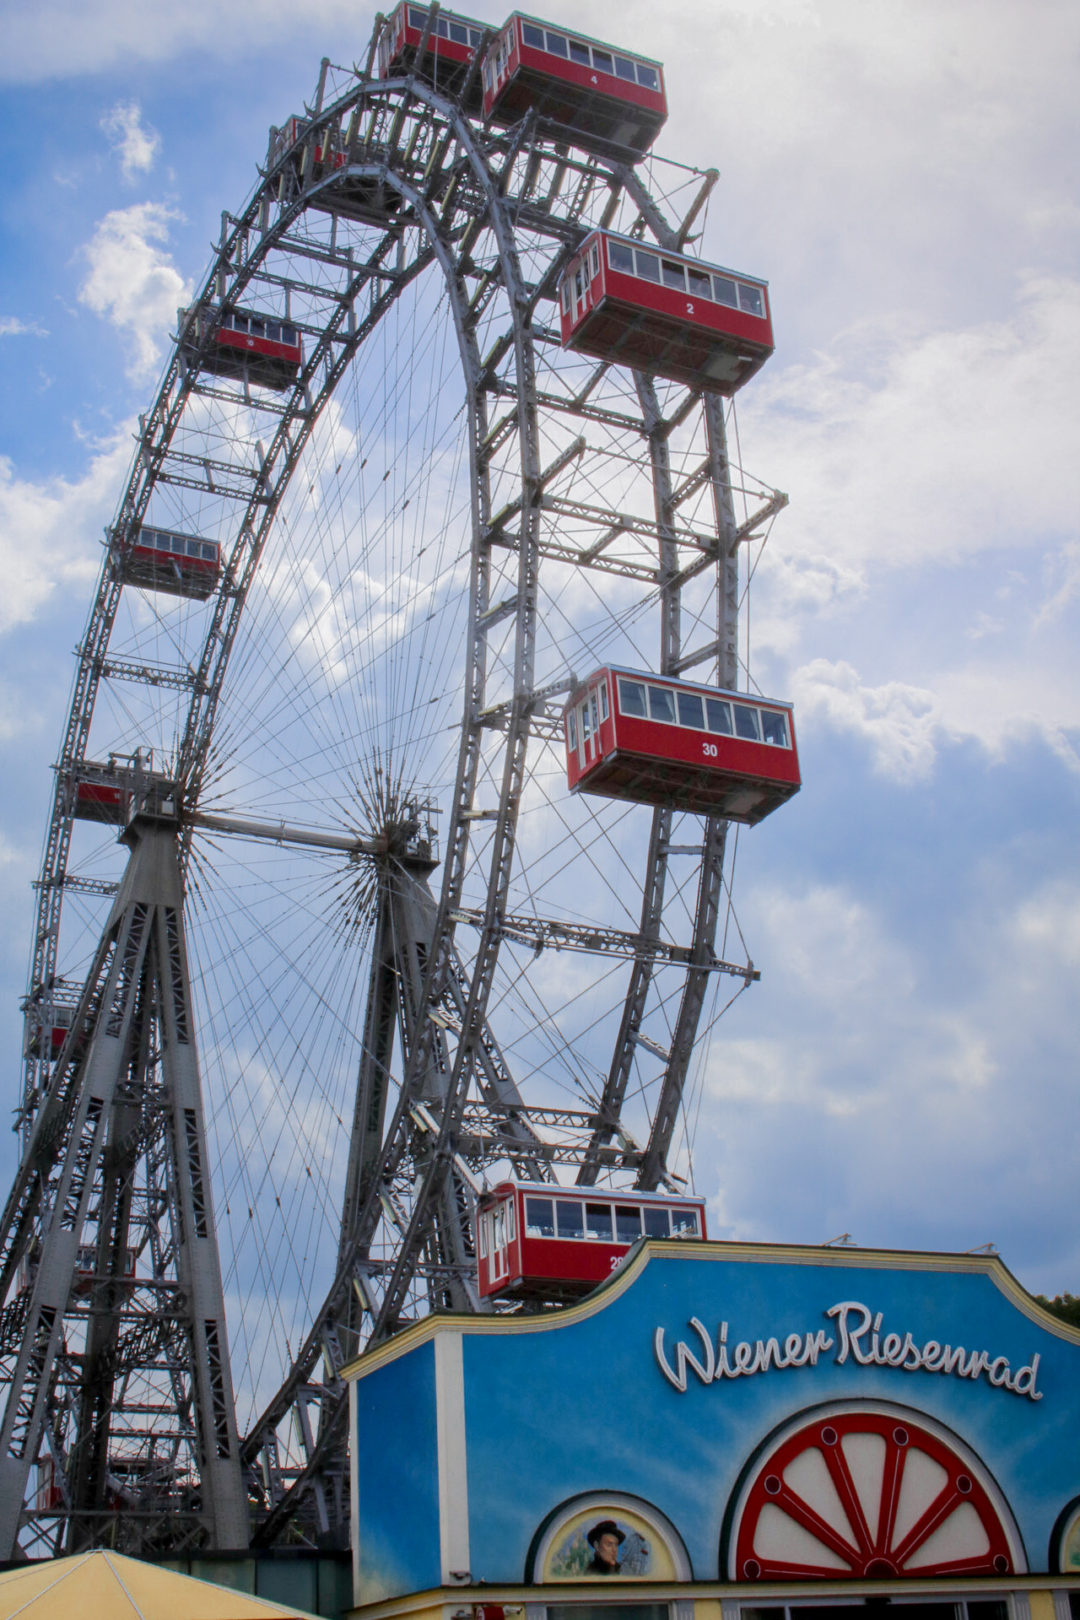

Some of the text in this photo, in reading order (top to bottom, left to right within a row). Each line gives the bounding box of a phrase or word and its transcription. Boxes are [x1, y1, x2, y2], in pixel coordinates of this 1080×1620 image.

[591, 75, 598, 85] 4
[686, 303, 694, 314] 2
[702, 743, 718, 757] 30
[655, 1301, 1043, 1400] Wiener Riesenrad
